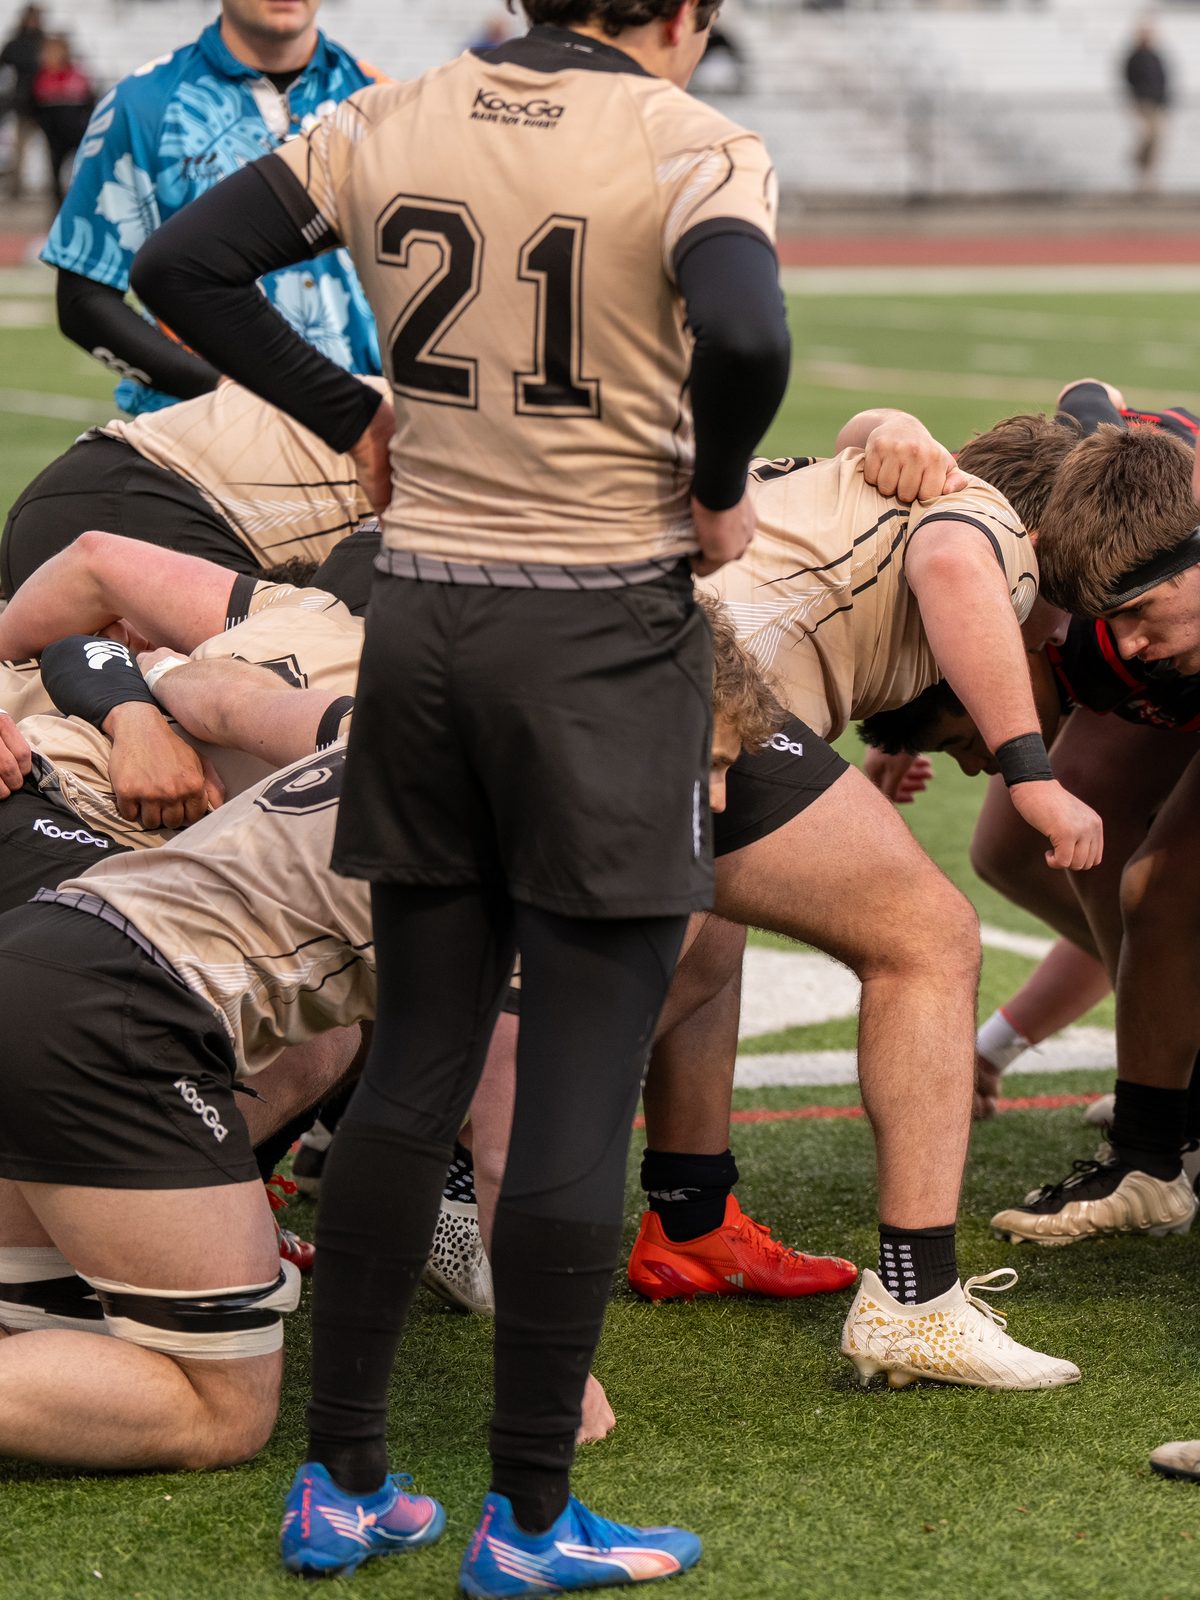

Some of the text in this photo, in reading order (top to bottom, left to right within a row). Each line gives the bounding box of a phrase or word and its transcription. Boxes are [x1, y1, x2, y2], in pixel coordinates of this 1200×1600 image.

[473, 88, 565, 118] KooGa
[375, 193, 601, 418] 21
[33, 818, 109, 848] KooGa
[173, 1077, 229, 1143] KooGa
